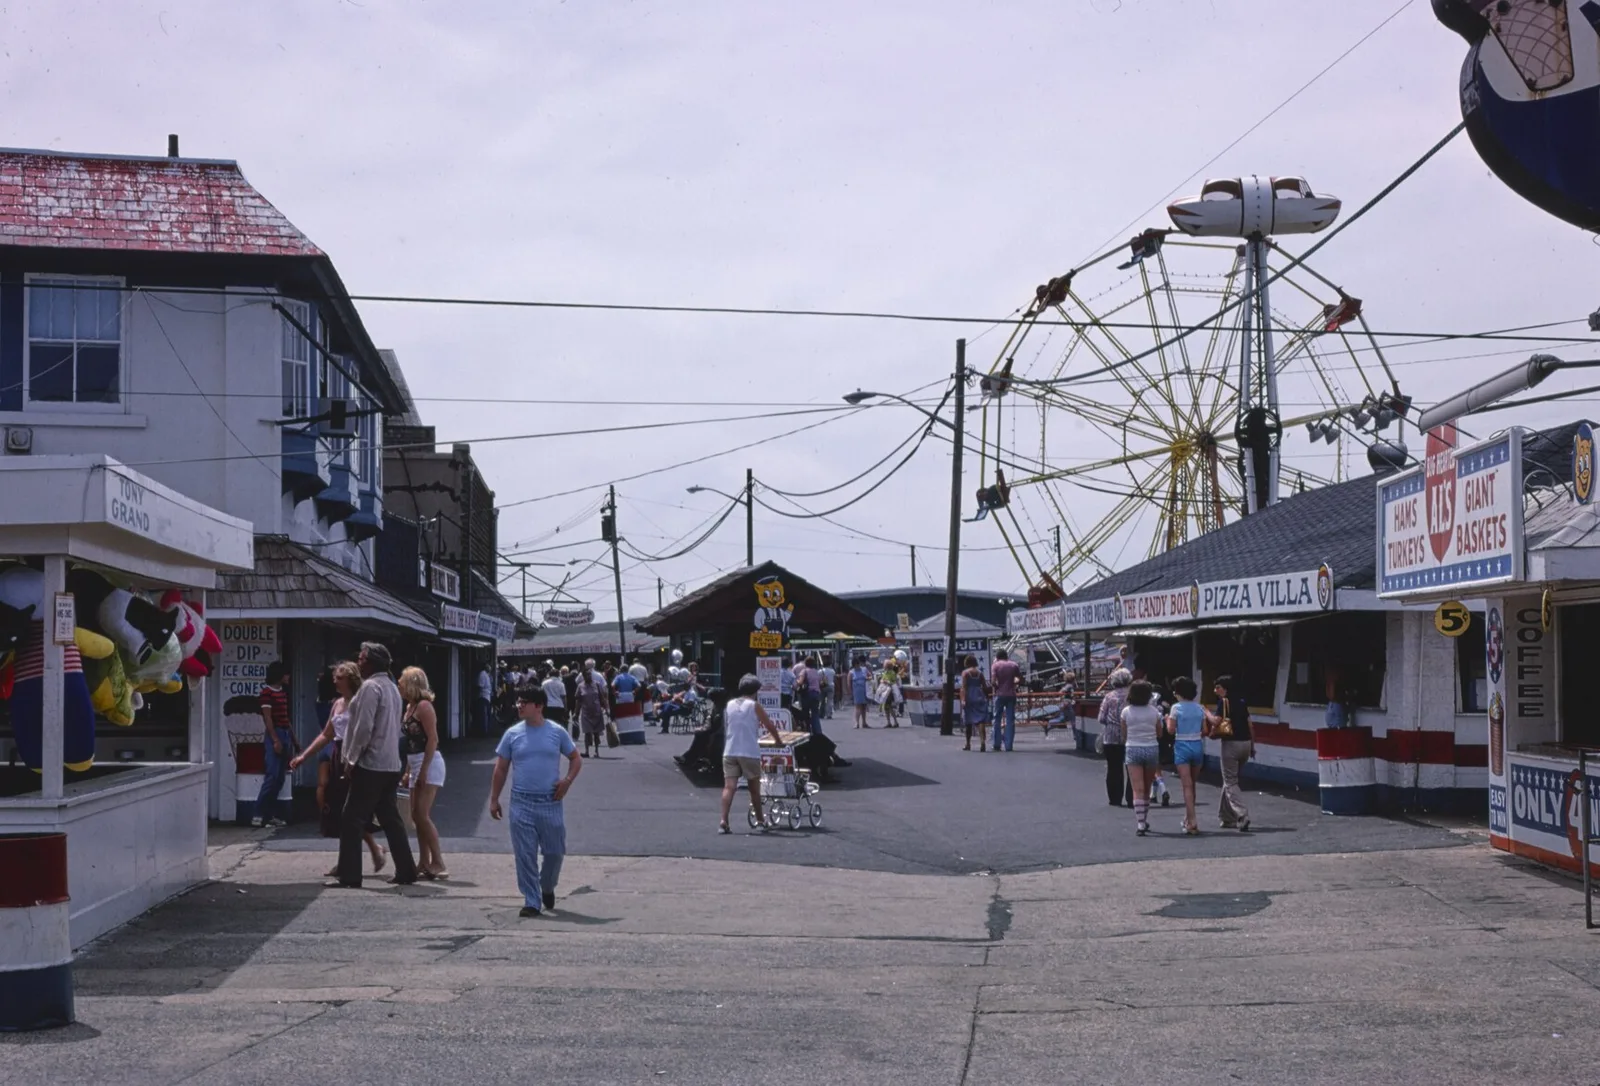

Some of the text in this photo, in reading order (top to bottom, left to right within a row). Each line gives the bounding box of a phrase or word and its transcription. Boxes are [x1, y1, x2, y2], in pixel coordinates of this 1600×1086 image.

[1426, 457, 1436, 478] BIG
[119, 476, 145, 506] TONY
[1465, 472, 1496, 513] GIANT
[111, 498, 150, 533] GRAND
[1394, 498, 1418, 533] HAMS
[1430, 479, 1453, 535] AL'S
[1456, 513, 1507, 556] BASKETS
[1388, 534, 1425, 570] TURKEYS
[1123, 590, 1190, 619] THE CANDY BOX
[1204, 577, 1313, 611] PIZZA VILLA
[224, 625, 274, 641] DOUBLE
[1025, 609, 1061, 630] CIGARETTES
[1441, 608, 1469, 631] 5¢
[237, 645, 261, 660] DIP
[928, 640, 983, 651] RO-JET
[223, 665, 267, 677] ICE CREA
[1516, 608, 1544, 717] COFFEE
[230, 681, 267, 695] CONES
[1491, 789, 1506, 808] EASY
[1514, 784, 1564, 826] ONLY
[1568, 793, 1584, 842] 4
